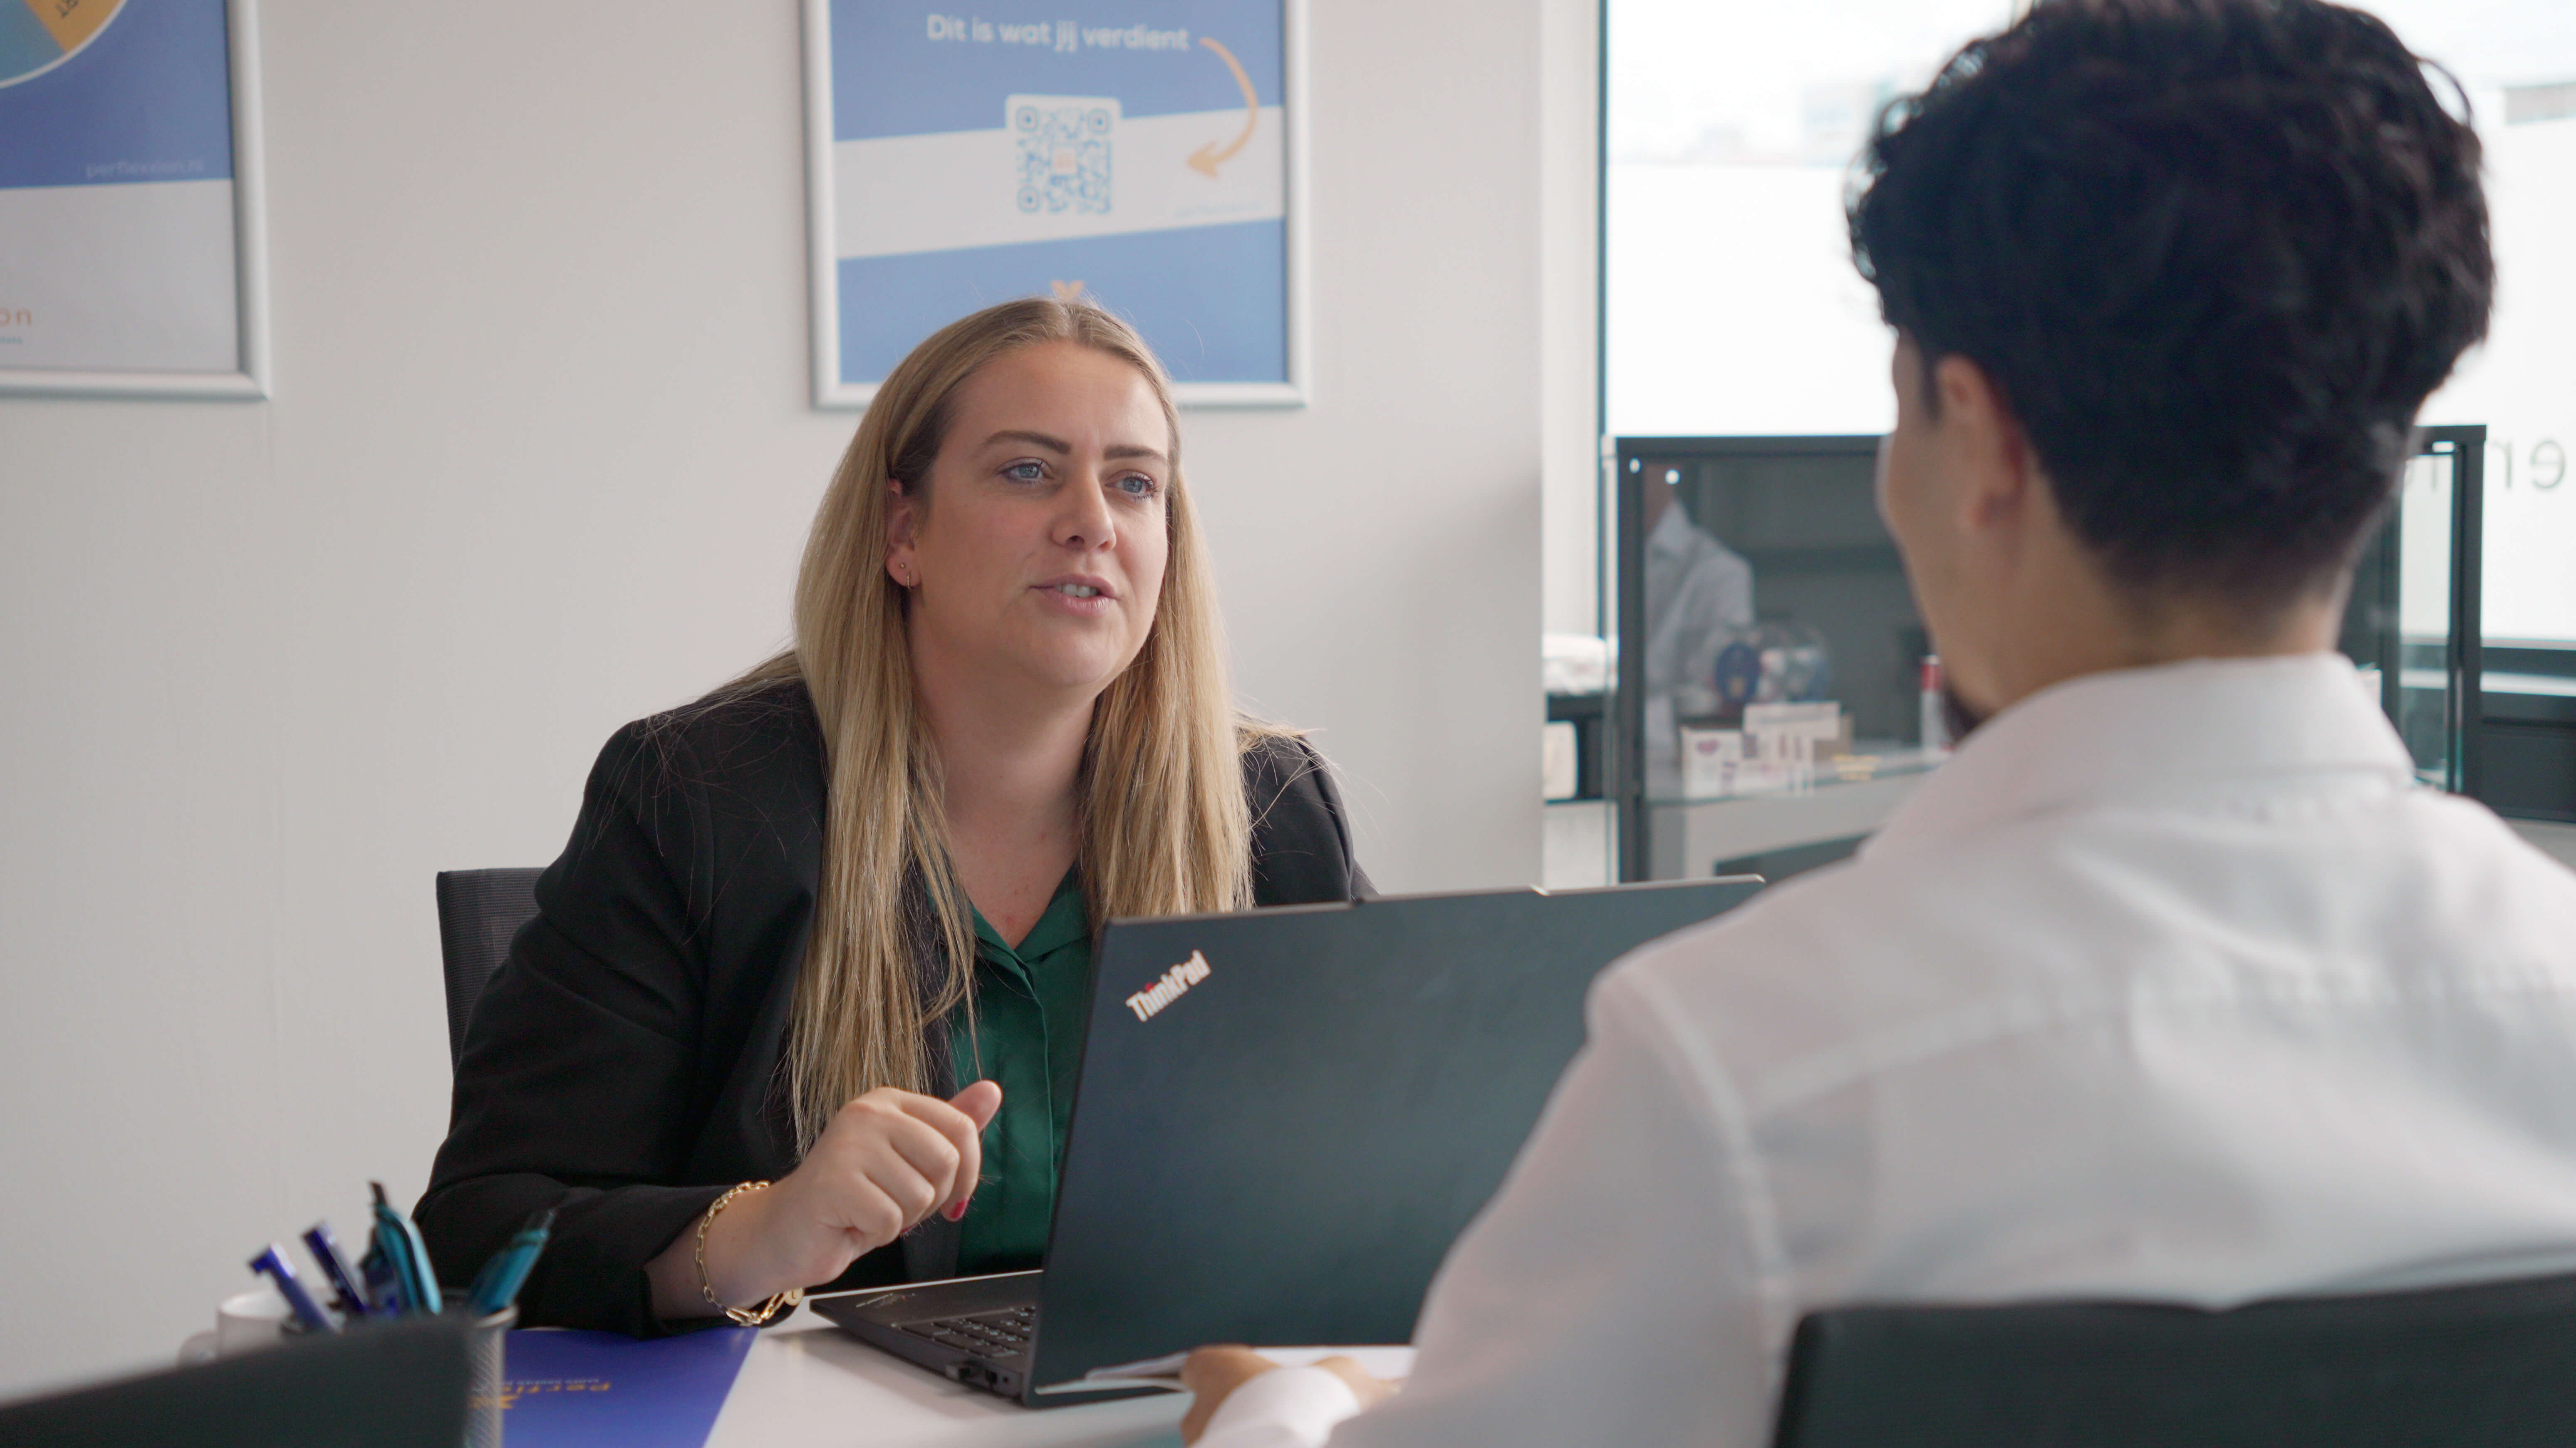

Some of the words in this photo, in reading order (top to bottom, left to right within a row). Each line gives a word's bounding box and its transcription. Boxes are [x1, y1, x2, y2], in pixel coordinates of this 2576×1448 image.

[927, 14, 967, 41] Dit
[972, 16, 995, 43] is
[998, 22, 1051, 46] wat
[1054, 19, 1078, 53] jij
[1082, 23, 1191, 53] verdient
[1125, 949, 1211, 1022] ThinkPad
